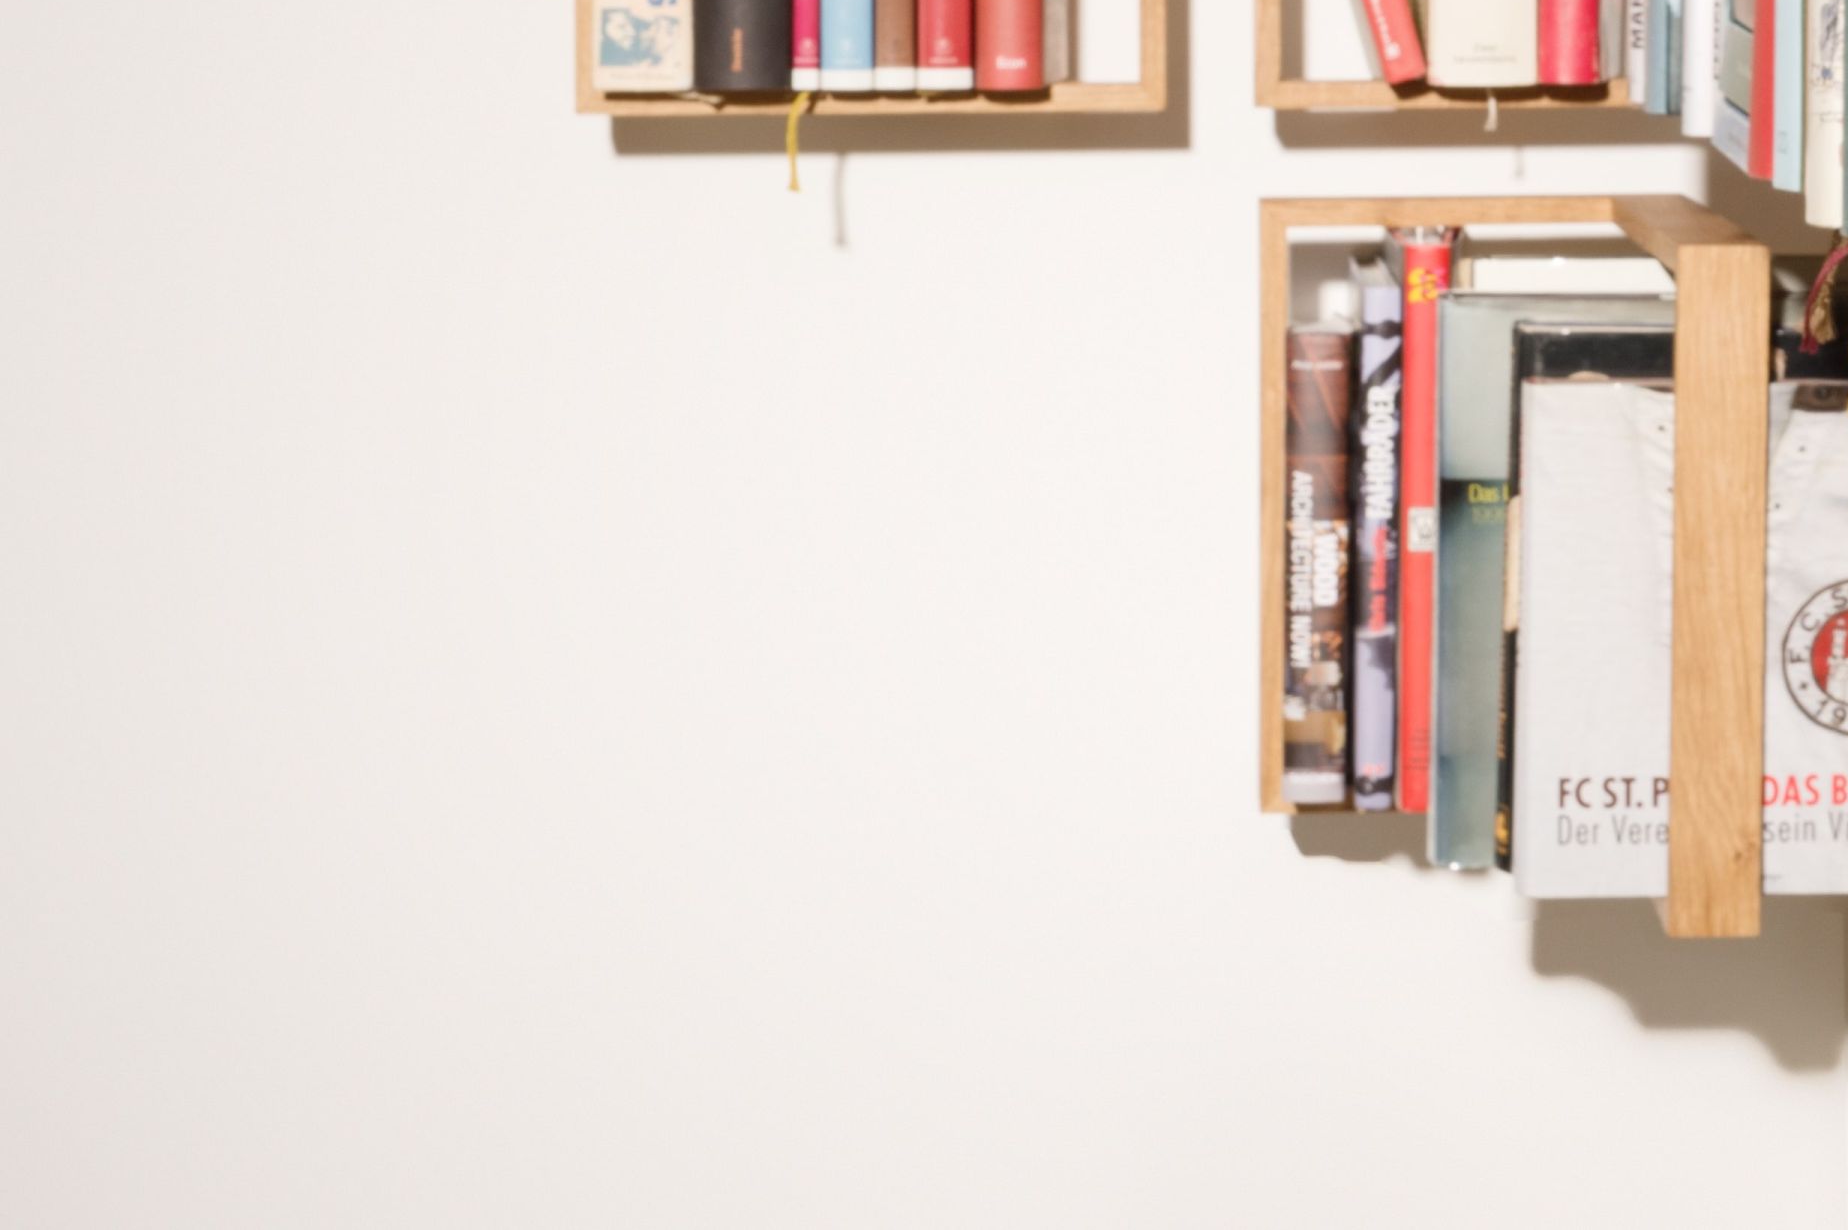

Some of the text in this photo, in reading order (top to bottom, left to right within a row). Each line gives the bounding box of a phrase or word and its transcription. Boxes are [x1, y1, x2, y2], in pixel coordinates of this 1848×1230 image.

[1289, 470, 1314, 669] ARCHITECTURE NOW!
[1313, 531, 1339, 608] WOOD
[1558, 776, 1592, 809] FC
[1602, 776, 1644, 809] ST.
[1652, 776, 1671, 809] P
[1761, 773, 1821, 808] DAS
[1557, 813, 1600, 847] Der
[1610, 813, 1671, 847] Vere
[1762, 812, 1817, 844] sein
